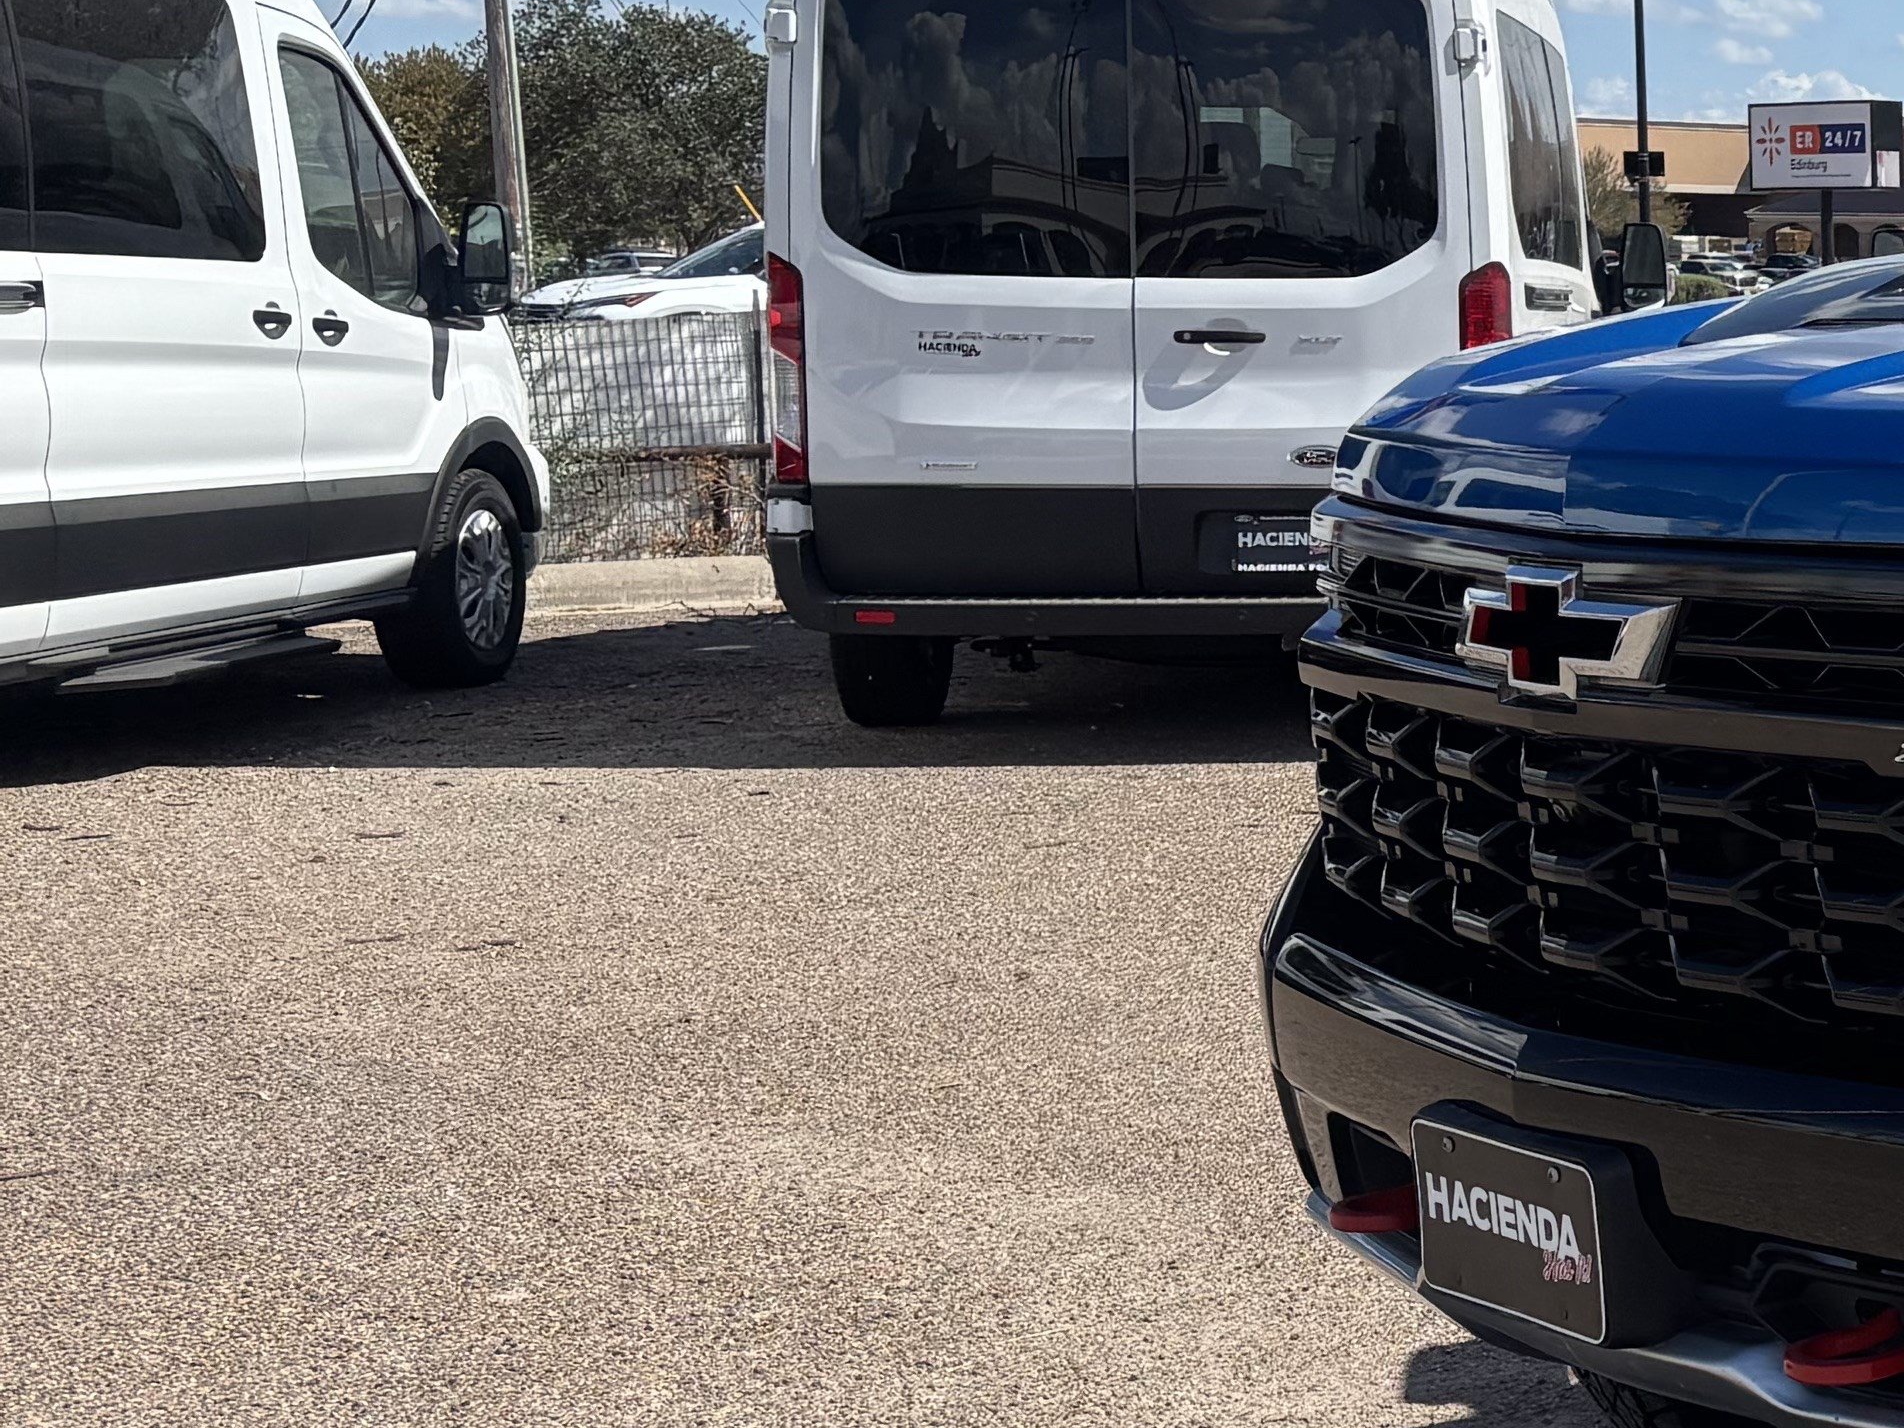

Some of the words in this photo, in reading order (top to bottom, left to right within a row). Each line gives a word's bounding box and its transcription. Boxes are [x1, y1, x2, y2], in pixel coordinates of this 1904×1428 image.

[1795, 131, 1814, 149] ER
[1824, 130, 1863, 148] 24/7
[1425, 1171, 1581, 1262] HACIENDA
